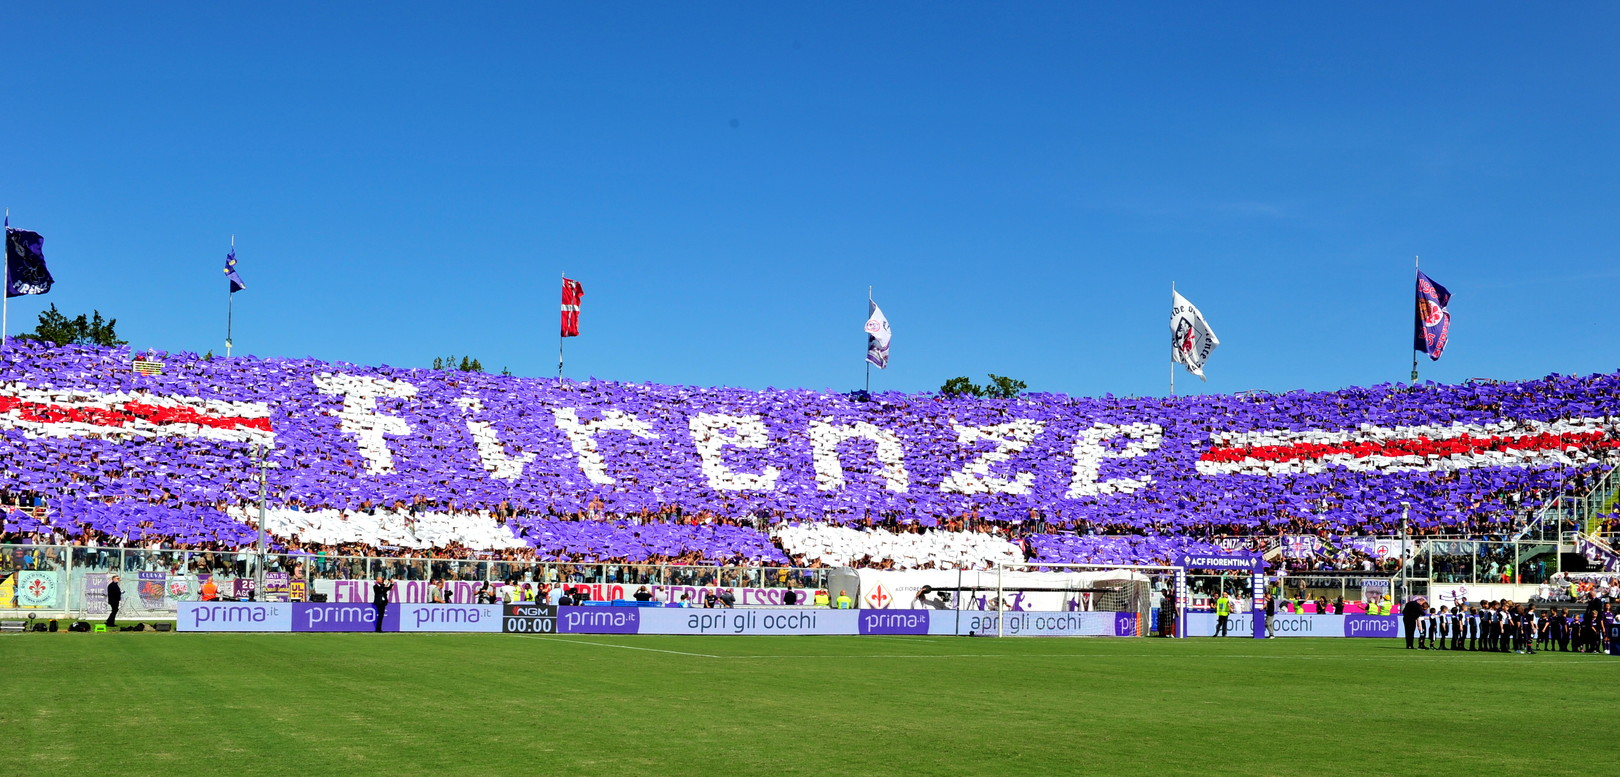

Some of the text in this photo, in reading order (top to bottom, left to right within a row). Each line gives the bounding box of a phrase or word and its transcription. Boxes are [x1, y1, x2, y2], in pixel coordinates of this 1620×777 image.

[312, 372, 1162, 499] Firenze
[1191, 558, 1250, 567] ACF FIORENTINA
[241, 580, 255, 589] 26
[190, 605, 279, 628] prima.it
[412, 607, 492, 628] prima.it
[517, 607, 549, 616] NGM
[564, 611, 636, 631] prima.it
[507, 618, 552, 633] 00:00
[687, 610, 817, 634] apri gli occhi
[864, 614, 926, 633] prima.it
[970, 613, 1082, 634] apr gli occhi
